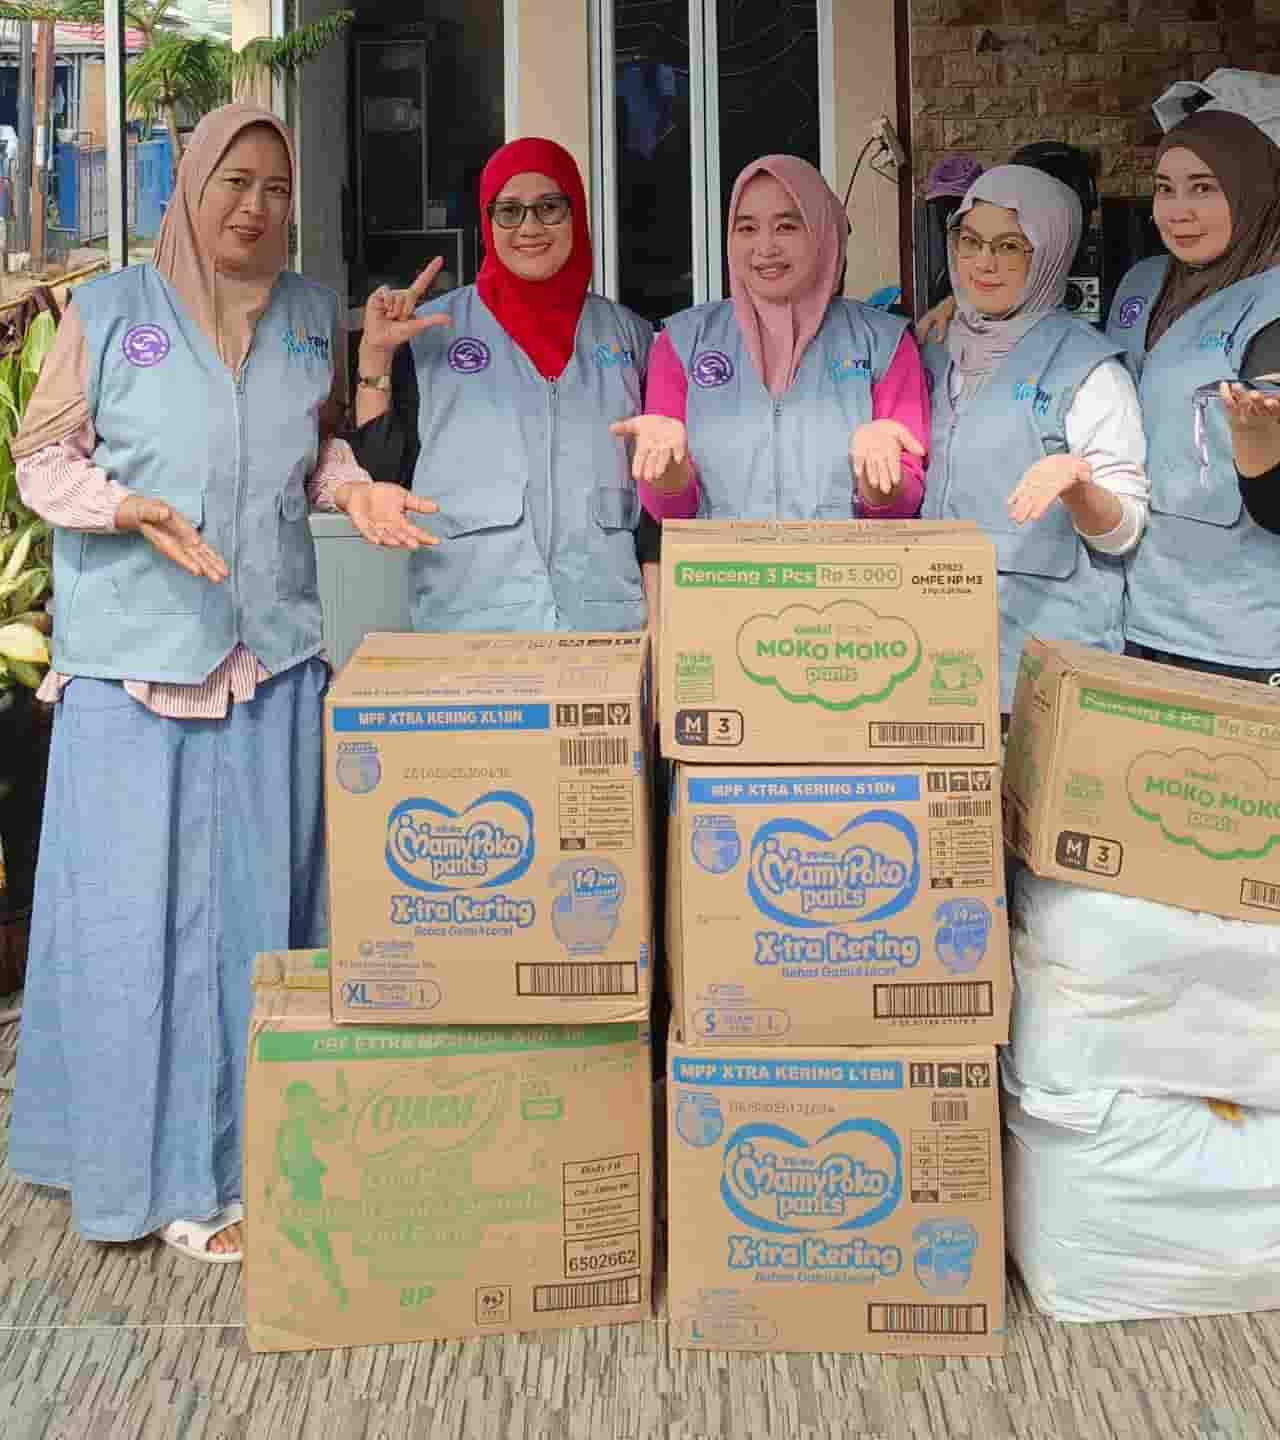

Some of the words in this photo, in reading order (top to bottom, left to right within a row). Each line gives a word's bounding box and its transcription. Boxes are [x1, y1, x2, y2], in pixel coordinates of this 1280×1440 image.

[756, 640, 829, 660] MOKO
[836, 640, 908, 660] MOKO
[686, 717, 705, 732] M
[718, 717, 730, 733] 3
[1144, 775, 1216, 808] MOKO
[1066, 839, 1083, 858] M
[1097, 844, 1111, 864] 3
[454, 894, 536, 928] Kering
[826, 929, 919, 968] Kering
[346, 983, 372, 1003] XL
[704, 1008, 716, 1033] S
[569, 1248, 637, 1273] 6502662
[802, 1235, 904, 1276] Kering
